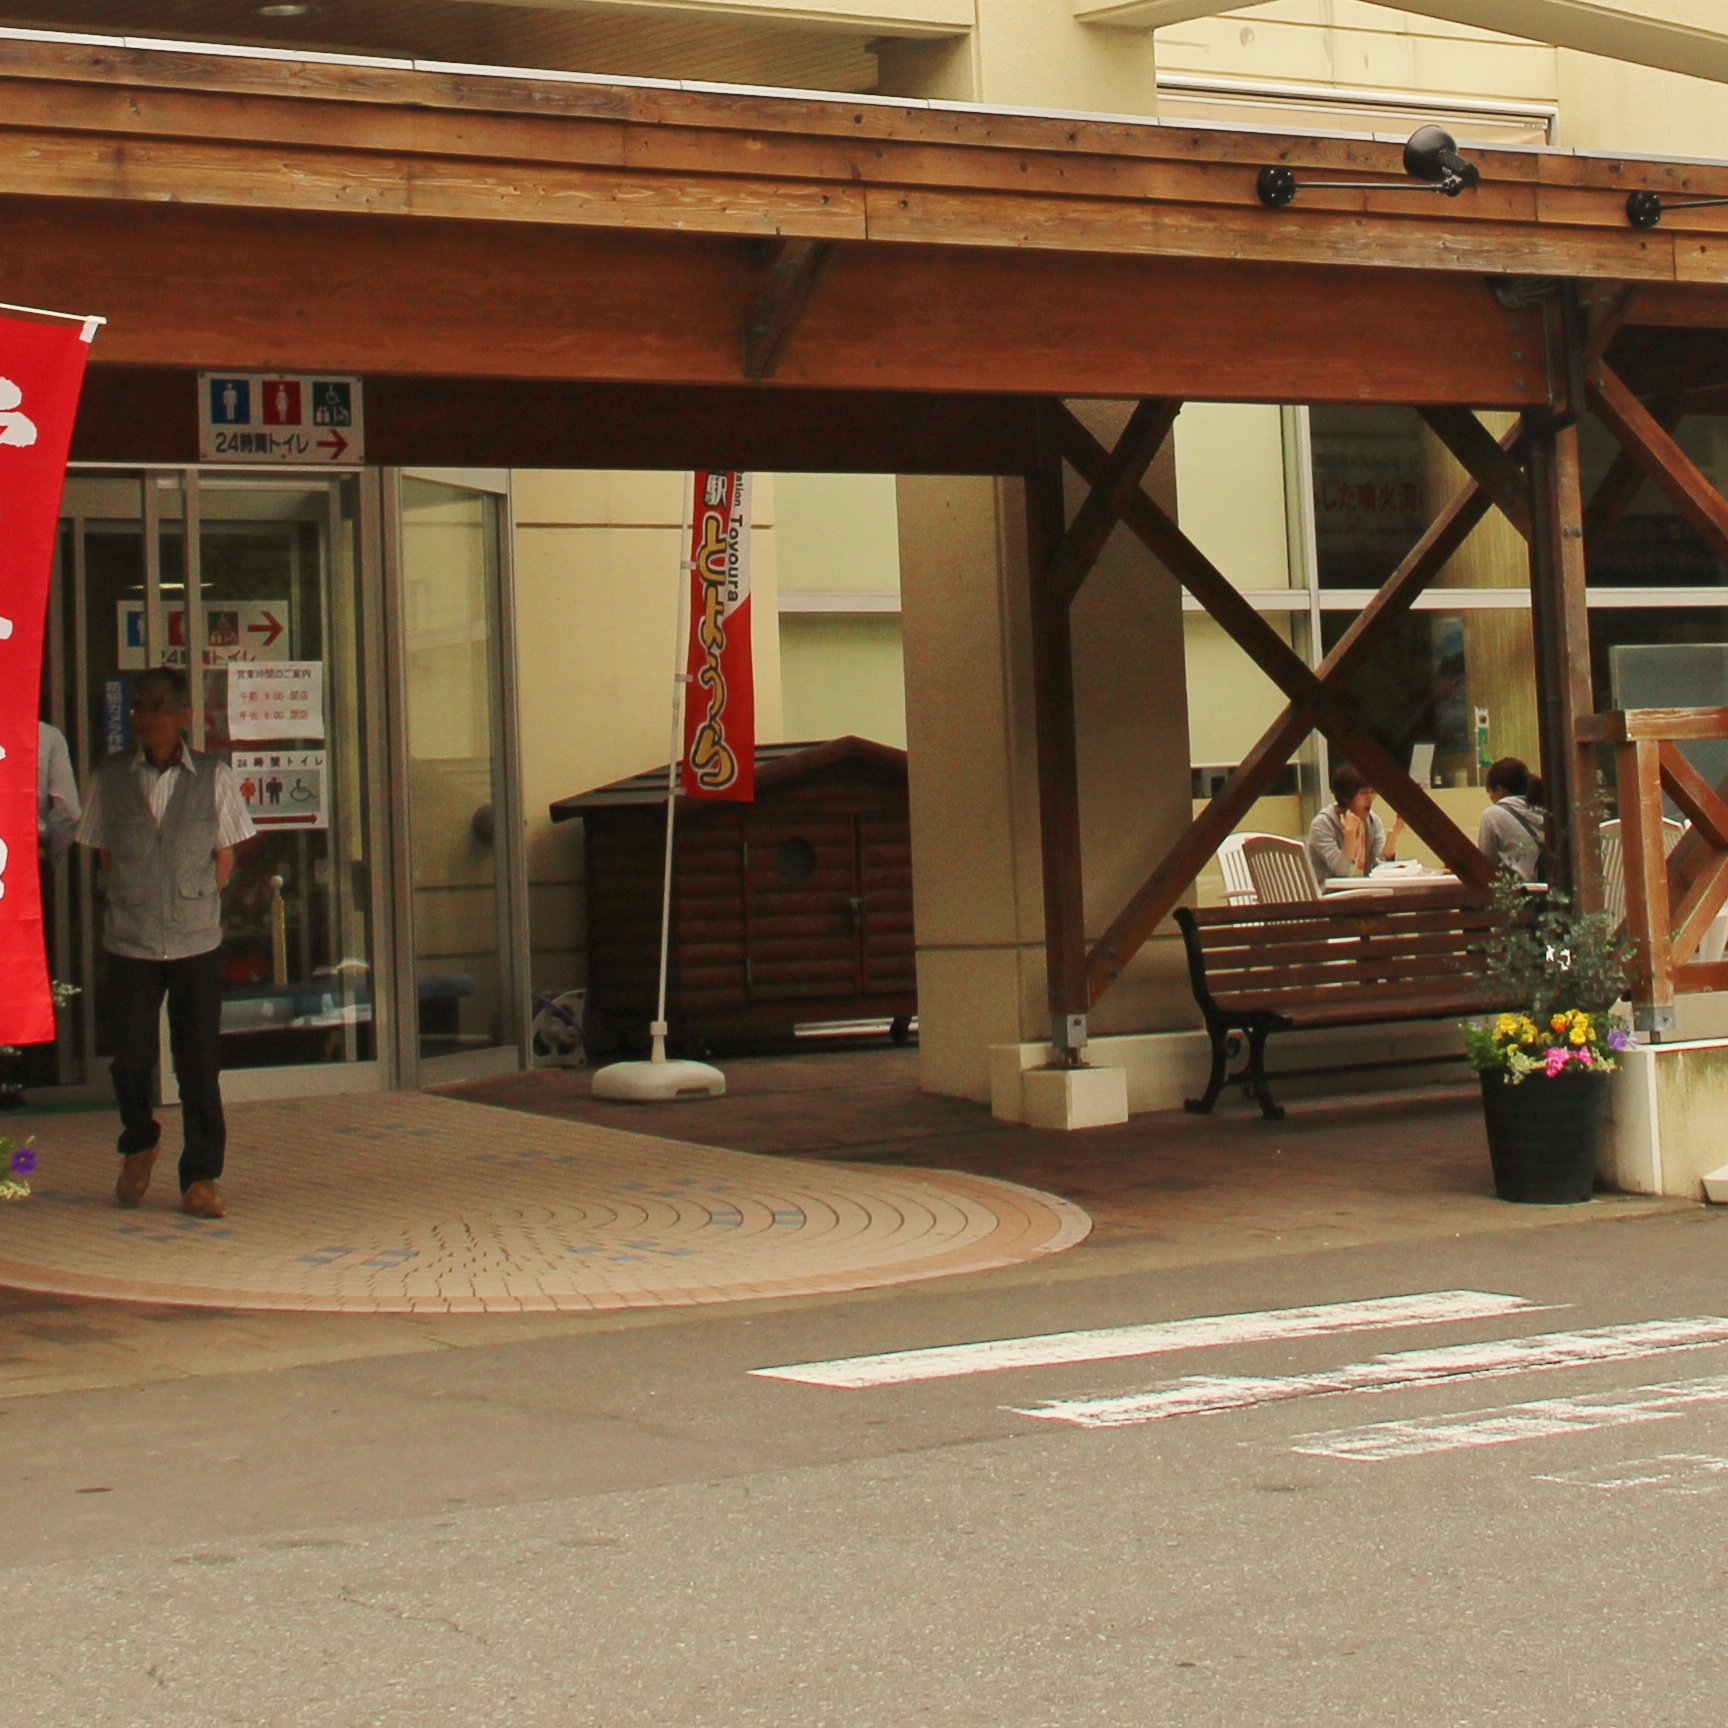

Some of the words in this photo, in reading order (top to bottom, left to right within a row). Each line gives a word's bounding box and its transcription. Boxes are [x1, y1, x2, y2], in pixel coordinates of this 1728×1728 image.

[215, 431, 310, 455] 24時間トイレ
[727, 514, 743, 603] Toyoura
